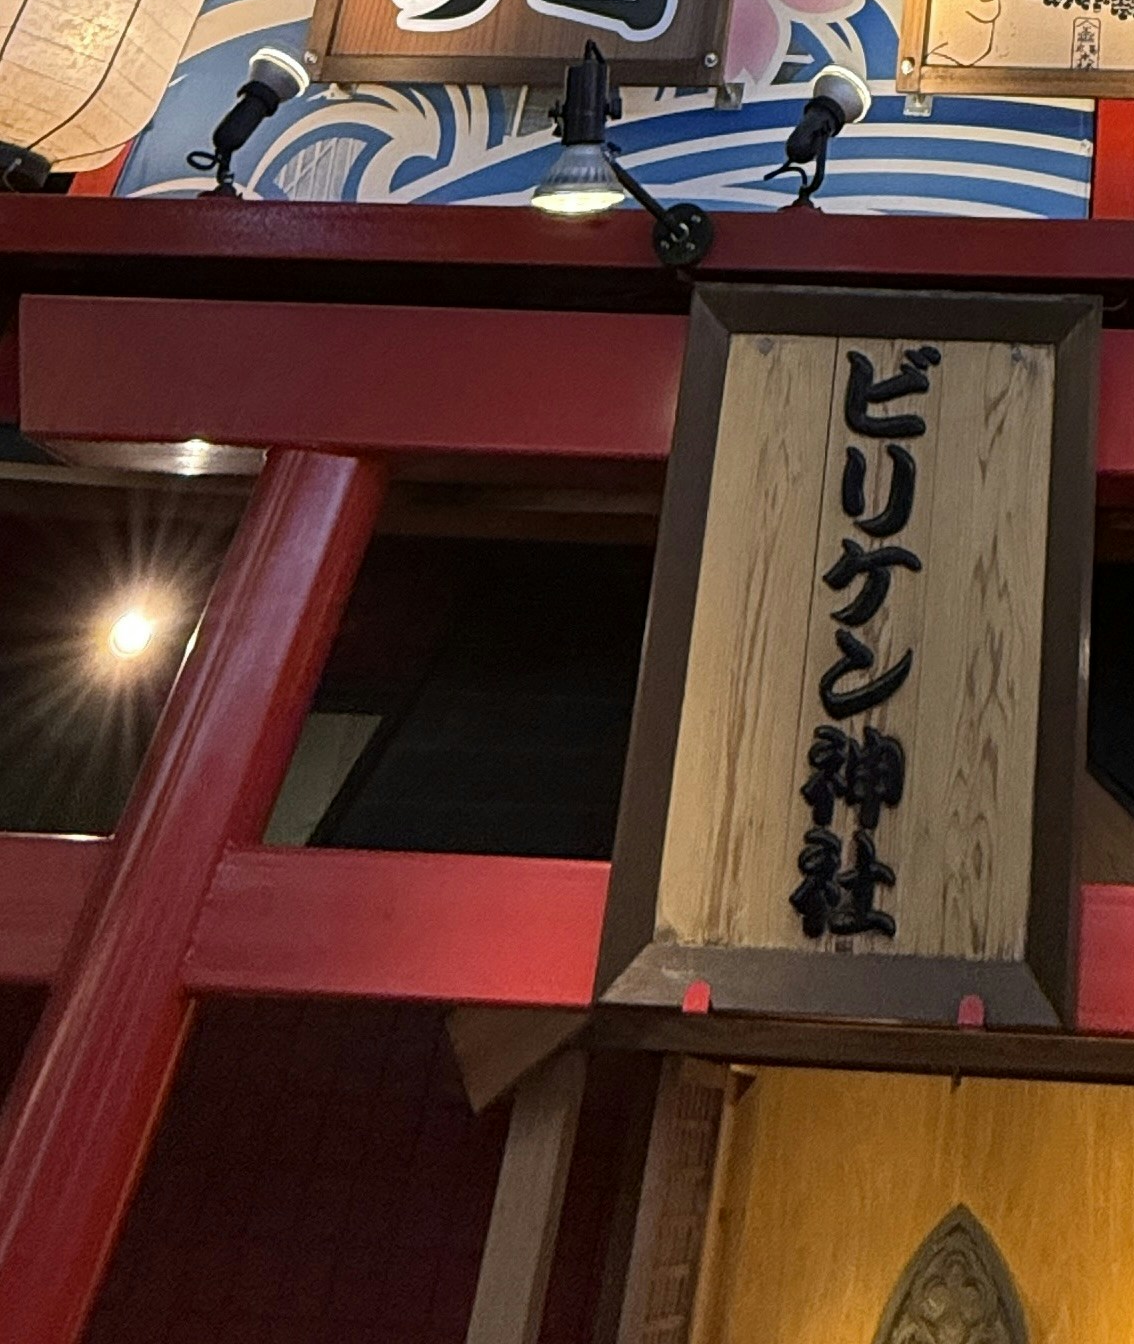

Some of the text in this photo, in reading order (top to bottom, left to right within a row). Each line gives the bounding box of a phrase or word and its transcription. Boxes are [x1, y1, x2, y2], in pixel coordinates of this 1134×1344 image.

[787, 345, 944, 942] ビリケン神社
